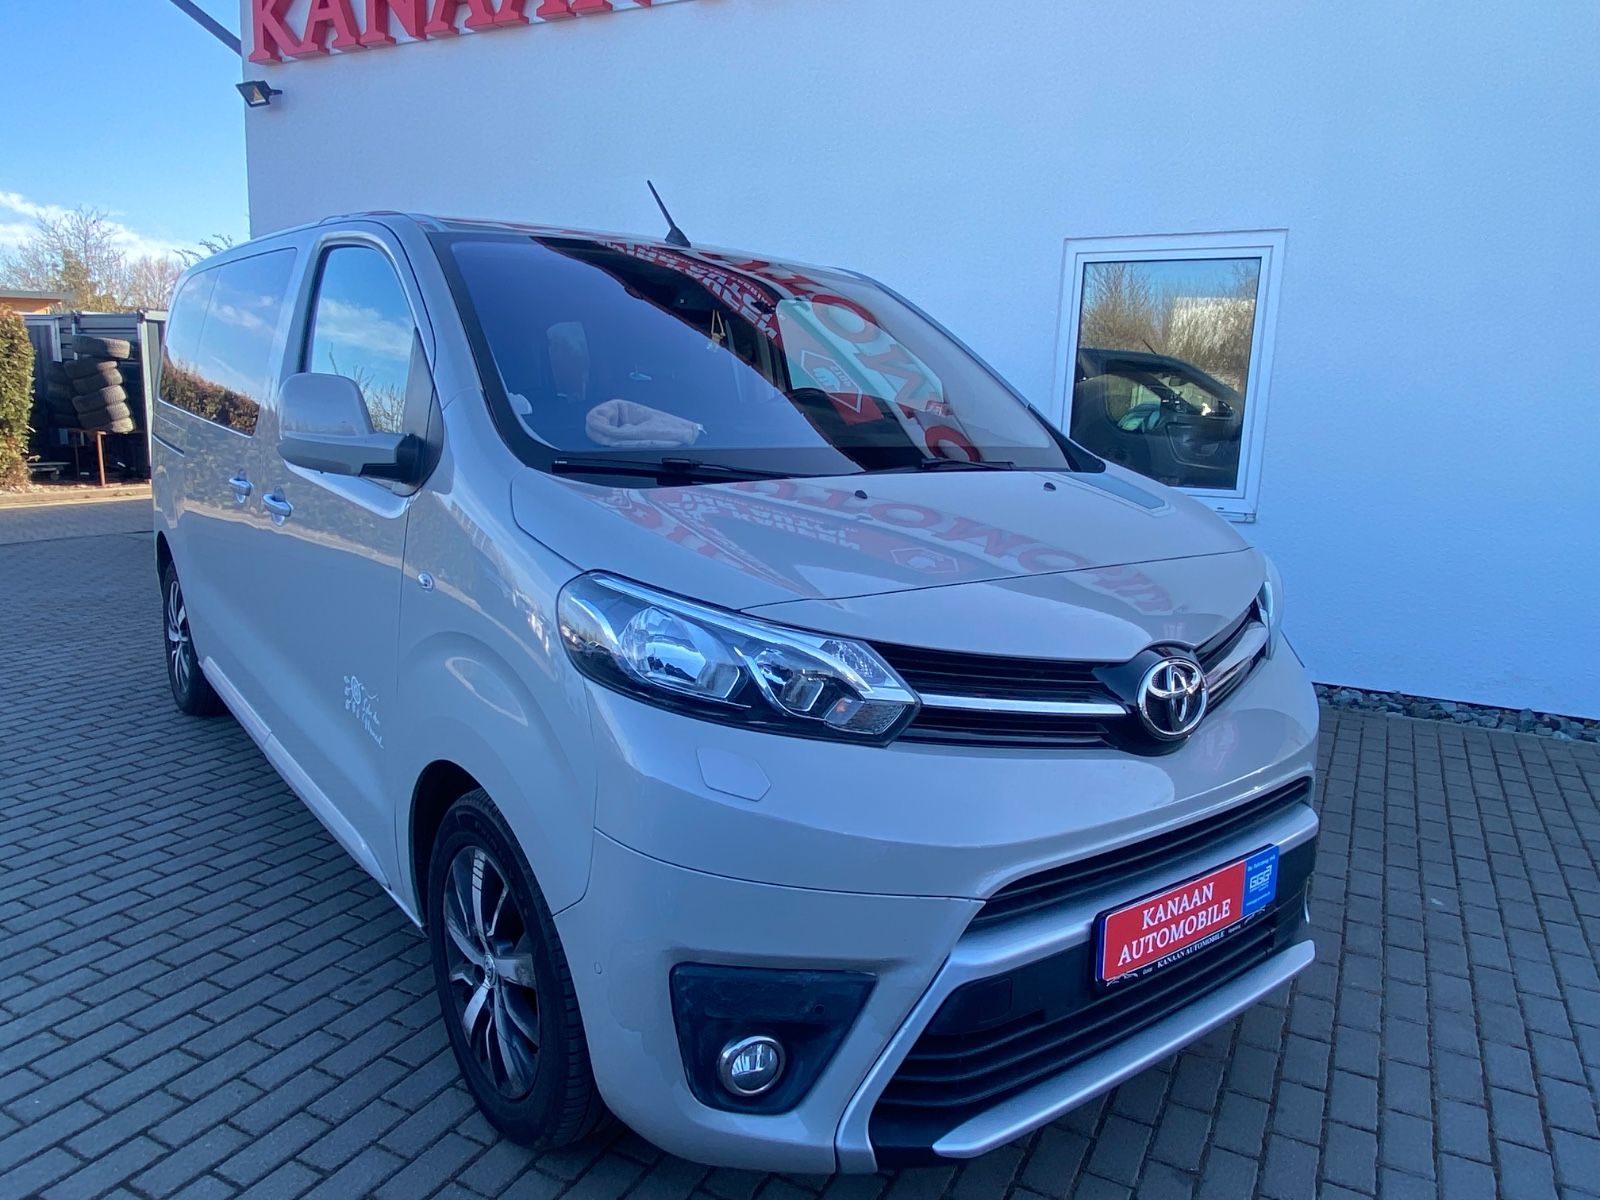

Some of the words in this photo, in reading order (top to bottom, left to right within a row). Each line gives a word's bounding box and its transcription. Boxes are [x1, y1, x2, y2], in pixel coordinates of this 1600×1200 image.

[1142, 882, 1214, 930] KANAAN
[1117, 899, 1231, 967] AUTOMOBILE
[1157, 950, 1186, 969] KANAAN
[1185, 930, 1225, 955] AUTOMOBILE
